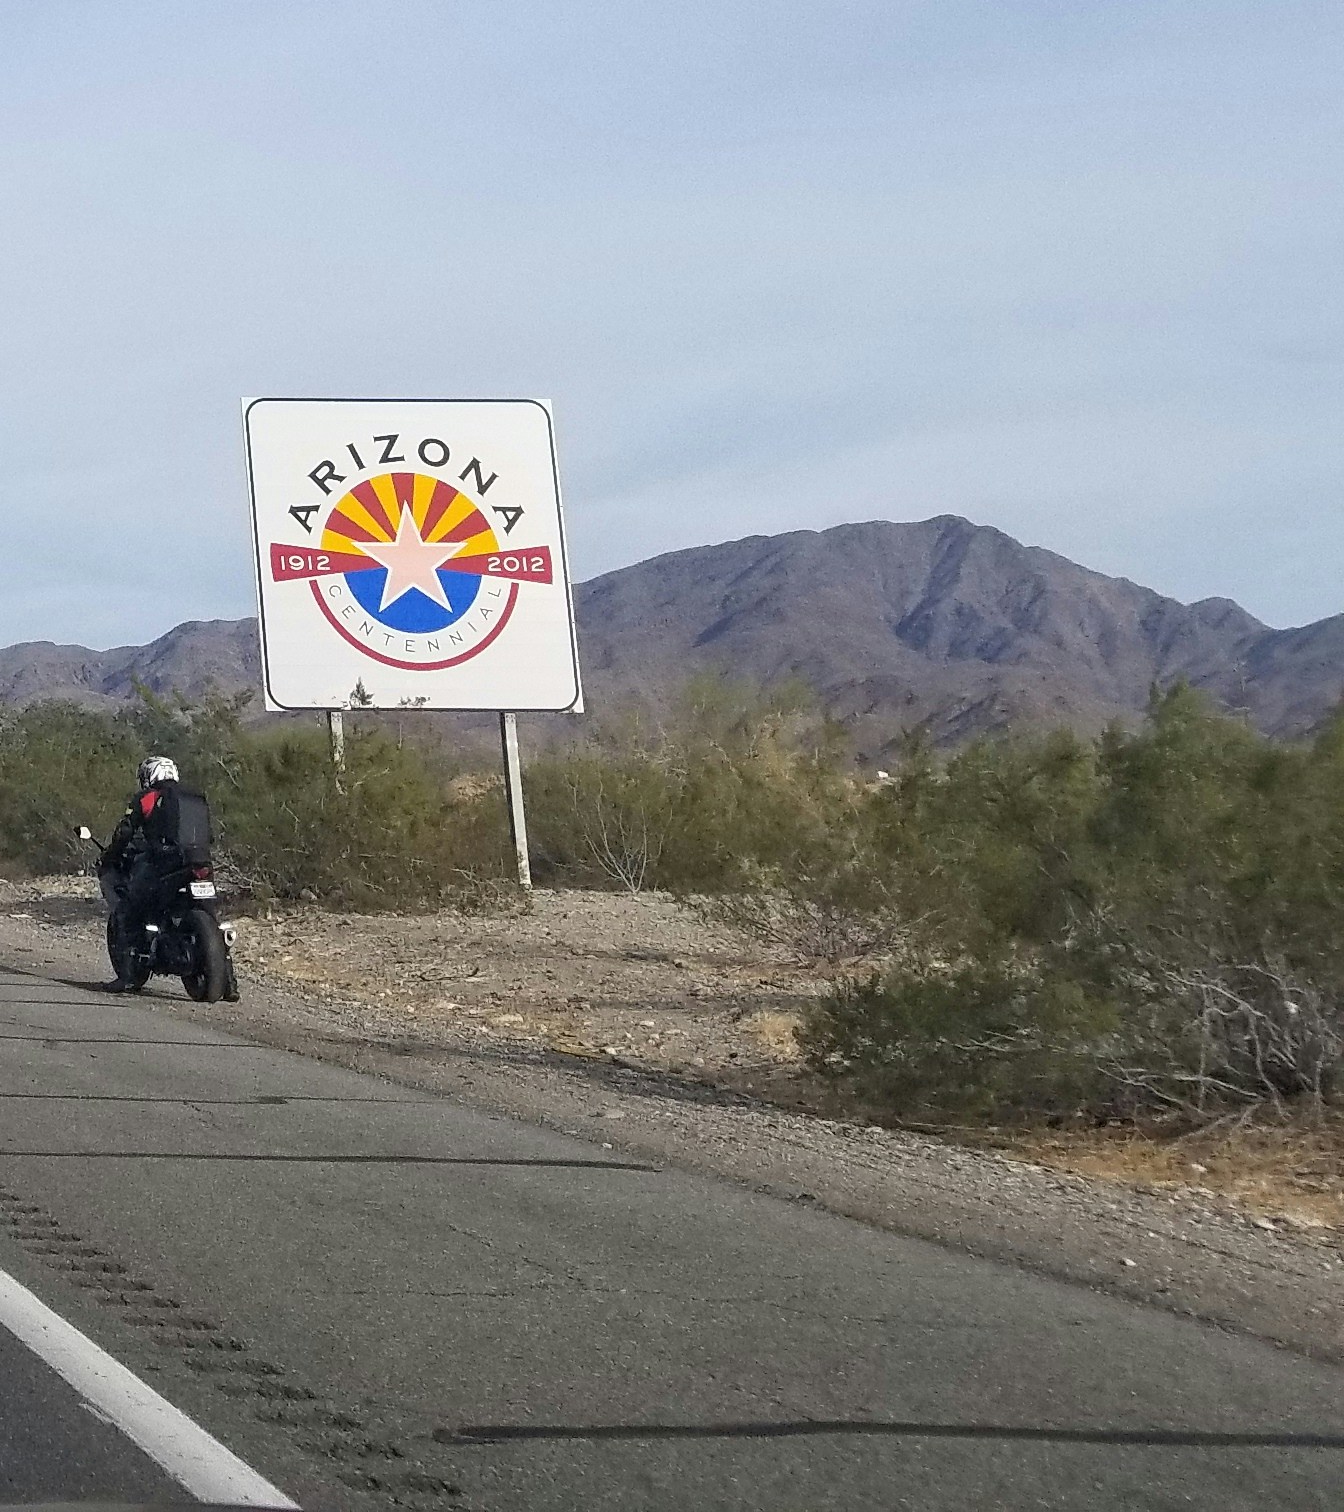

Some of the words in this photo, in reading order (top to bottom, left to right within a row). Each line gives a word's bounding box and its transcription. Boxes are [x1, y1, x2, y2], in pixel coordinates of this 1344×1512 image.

[287, 433, 525, 535] ARIZONA
[279, 555, 332, 571] 1912
[487, 556, 545, 573] 2012
[328, 584, 502, 653] CENTENNIAL
